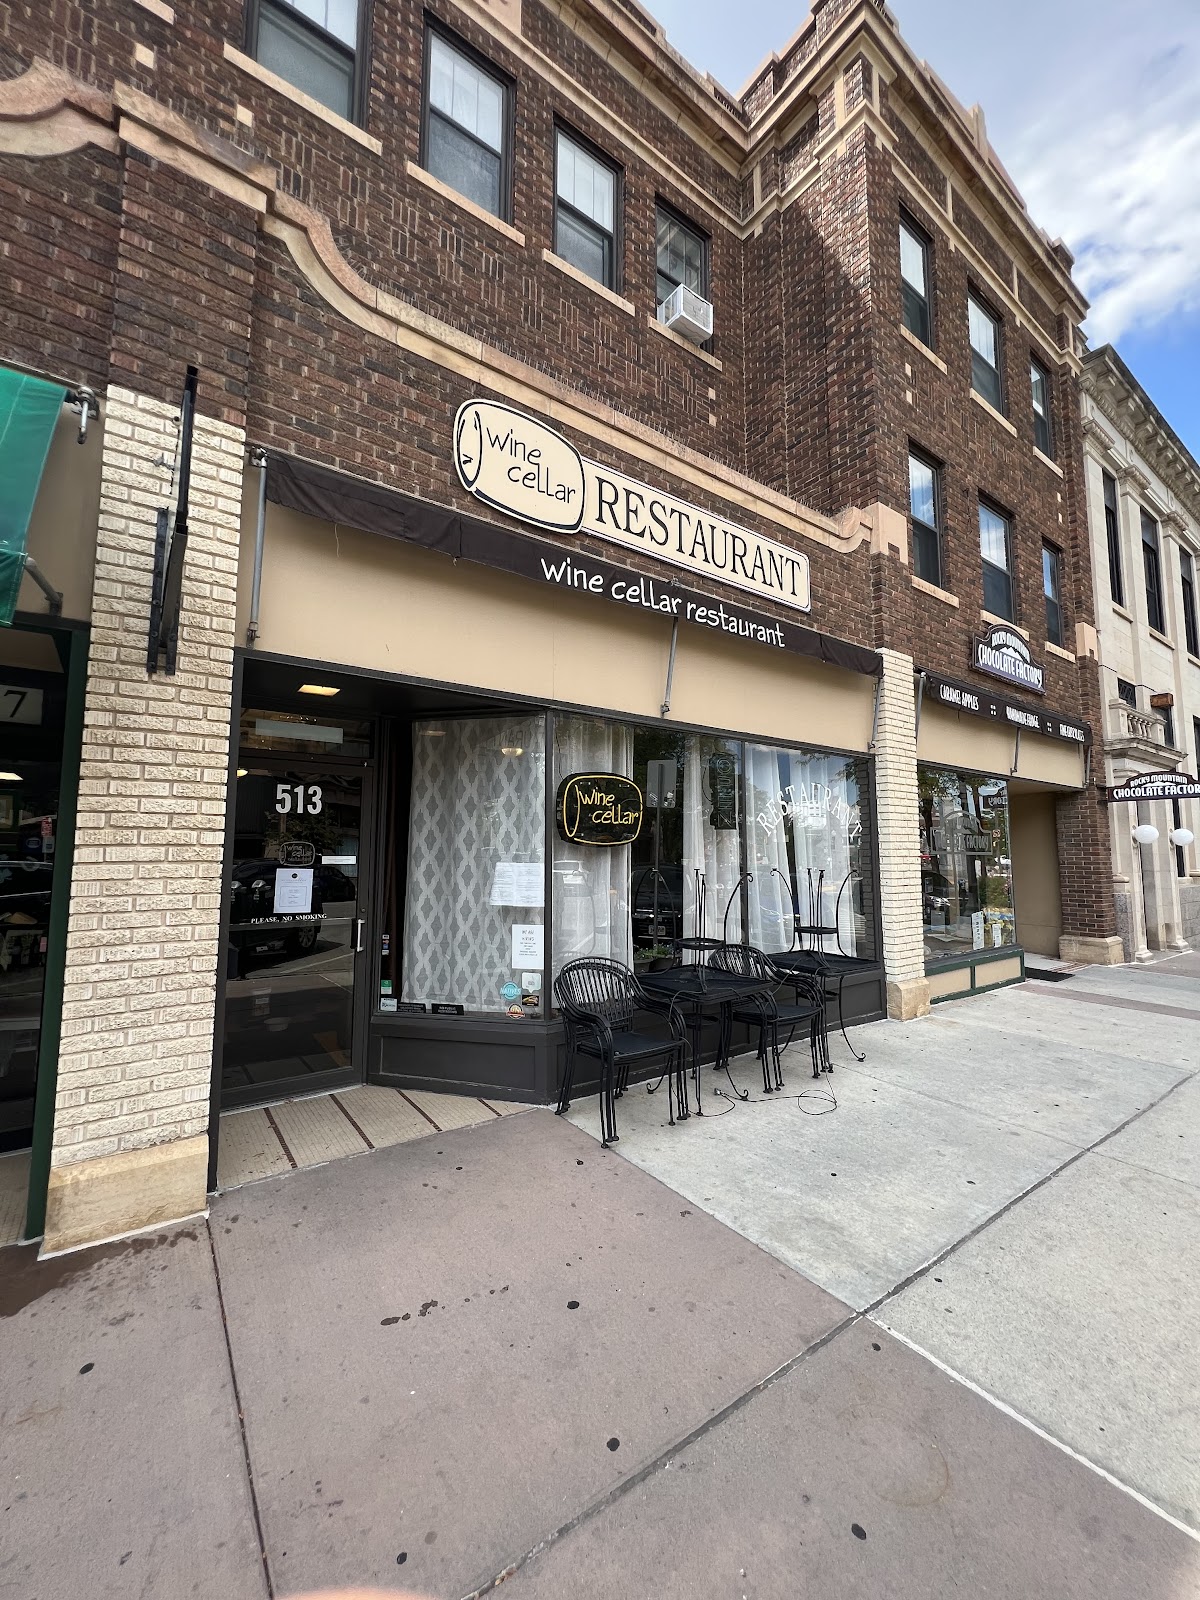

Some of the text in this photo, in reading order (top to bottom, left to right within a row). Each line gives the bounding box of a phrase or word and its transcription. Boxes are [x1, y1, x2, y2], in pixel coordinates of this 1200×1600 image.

[486, 428, 541, 466] wine
[507, 463, 576, 505] cellar
[595, 476, 801, 597] RESTAURANT
[540, 557, 786, 648] wine cellar restaurant
[991, 631, 1006, 647] ROCKY
[978, 643, 1042, 688] CHOCOLATE FACTORY
[3, 690, 27, 718] 7
[939, 684, 979, 711] CARAMEL APPLES
[1113, 786, 1161, 800] CHOCOLATE
[1130, 774, 1188, 788] ROCKY MOUNTAIN
[276, 784, 322, 815] 513
[579, 787, 615, 807] wine
[591, 804, 639, 825] cellar
[756, 782, 863, 842] RESTAURANT
[251, 916, 280, 925] PLEASE,
[295, 913, 327, 922] SMOKING
